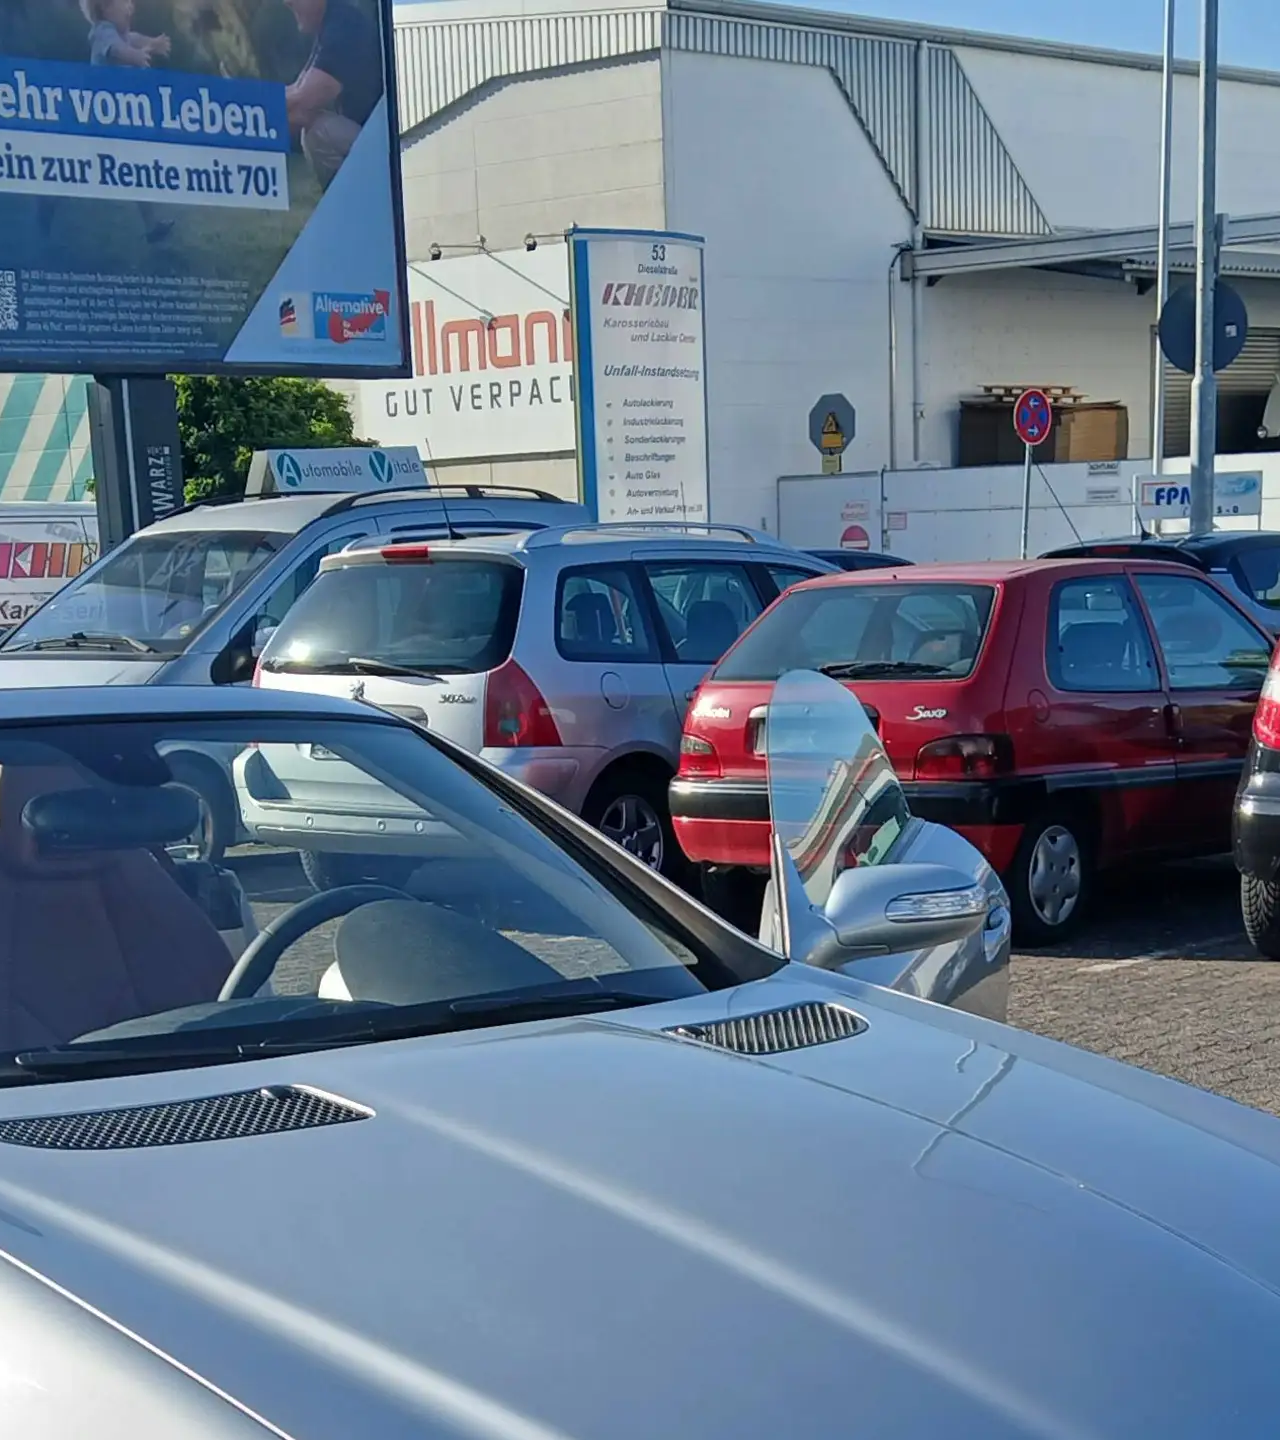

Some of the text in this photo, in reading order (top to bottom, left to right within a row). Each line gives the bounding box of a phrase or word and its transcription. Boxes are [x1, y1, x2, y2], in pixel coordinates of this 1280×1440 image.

[70, 88, 155, 127] vom
[159, 86, 278, 139] Leben.
[42, 156, 93, 185] zur
[97, 153, 179, 191] Rente
[186, 159, 233, 193] mit
[238, 165, 278, 197] 70!
[652, 244, 666, 261] 53
[315, 295, 384, 314] Alternative
[603, 318, 669, 328] Karosseriebau
[631, 332, 649, 342] und
[603, 365, 699, 381] Unfall-Instandsetzung
[385, 375, 574, 418] GUT VERPAC
[622, 398, 673, 409] Autolackierung
[277, 451, 419, 487] Automobile Vitale
[625, 470, 660, 480] Auto Glas
[905, 705, 947, 720] Saxo
